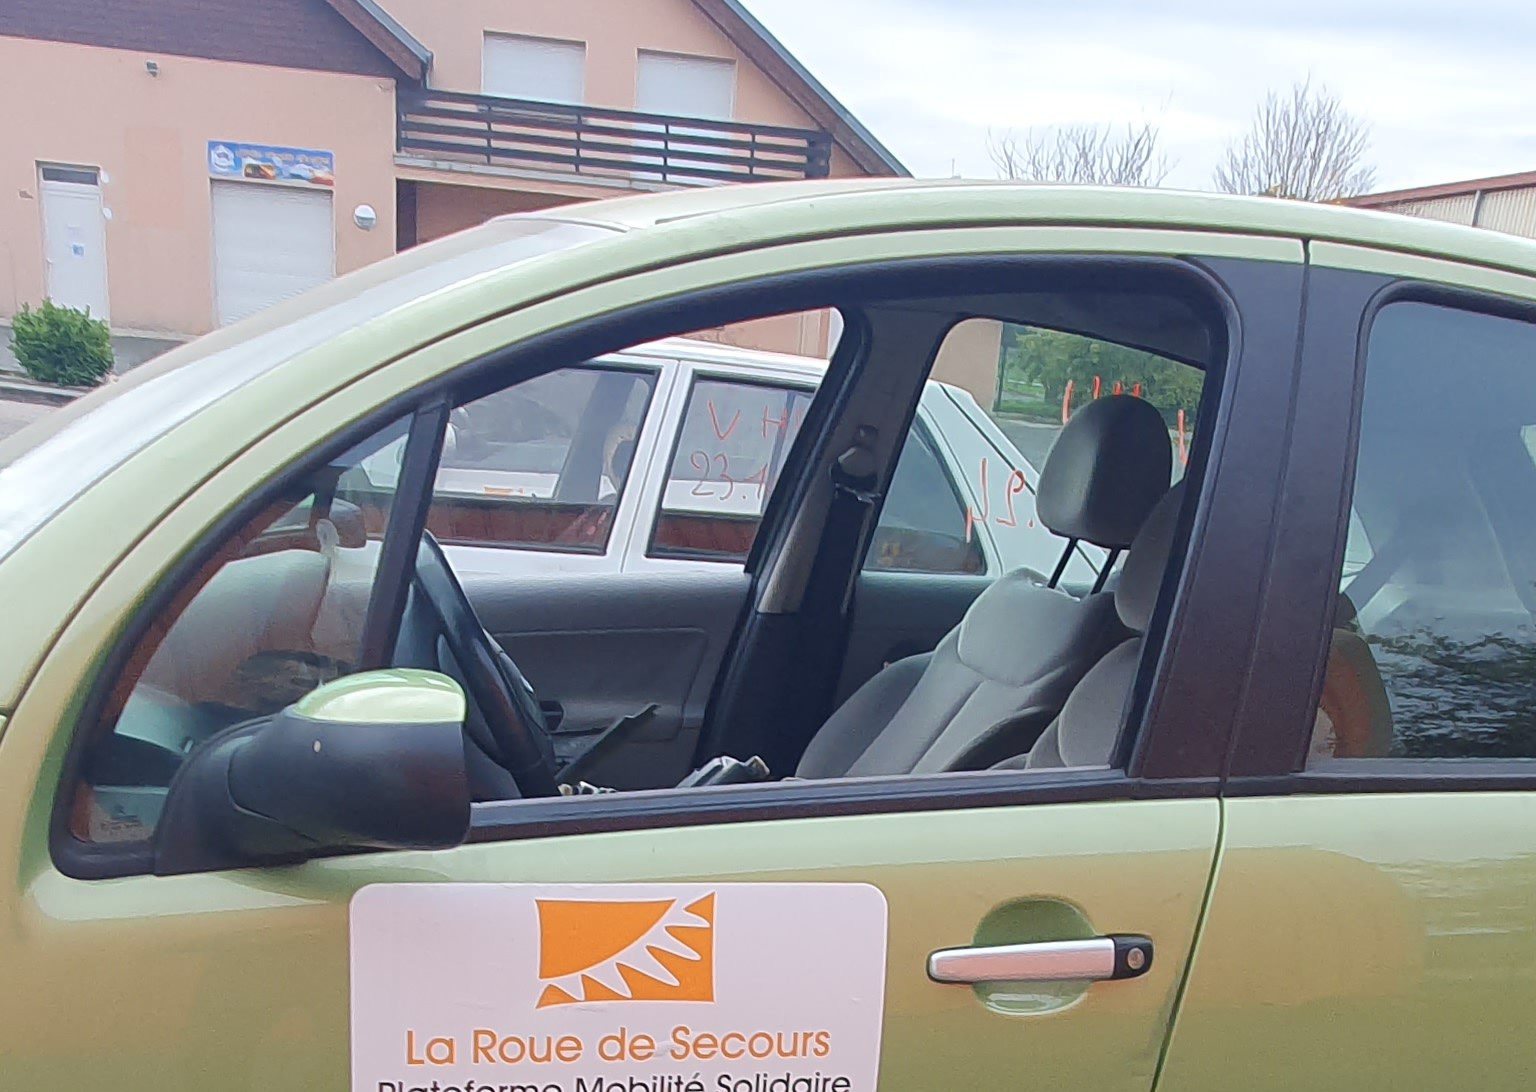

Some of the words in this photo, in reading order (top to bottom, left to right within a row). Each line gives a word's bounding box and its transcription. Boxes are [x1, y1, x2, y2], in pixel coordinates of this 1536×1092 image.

[406, 1029, 455, 1065] La
[472, 1029, 583, 1064] Roue
[598, 1026, 655, 1061] de
[669, 1025, 832, 1060] Secours
